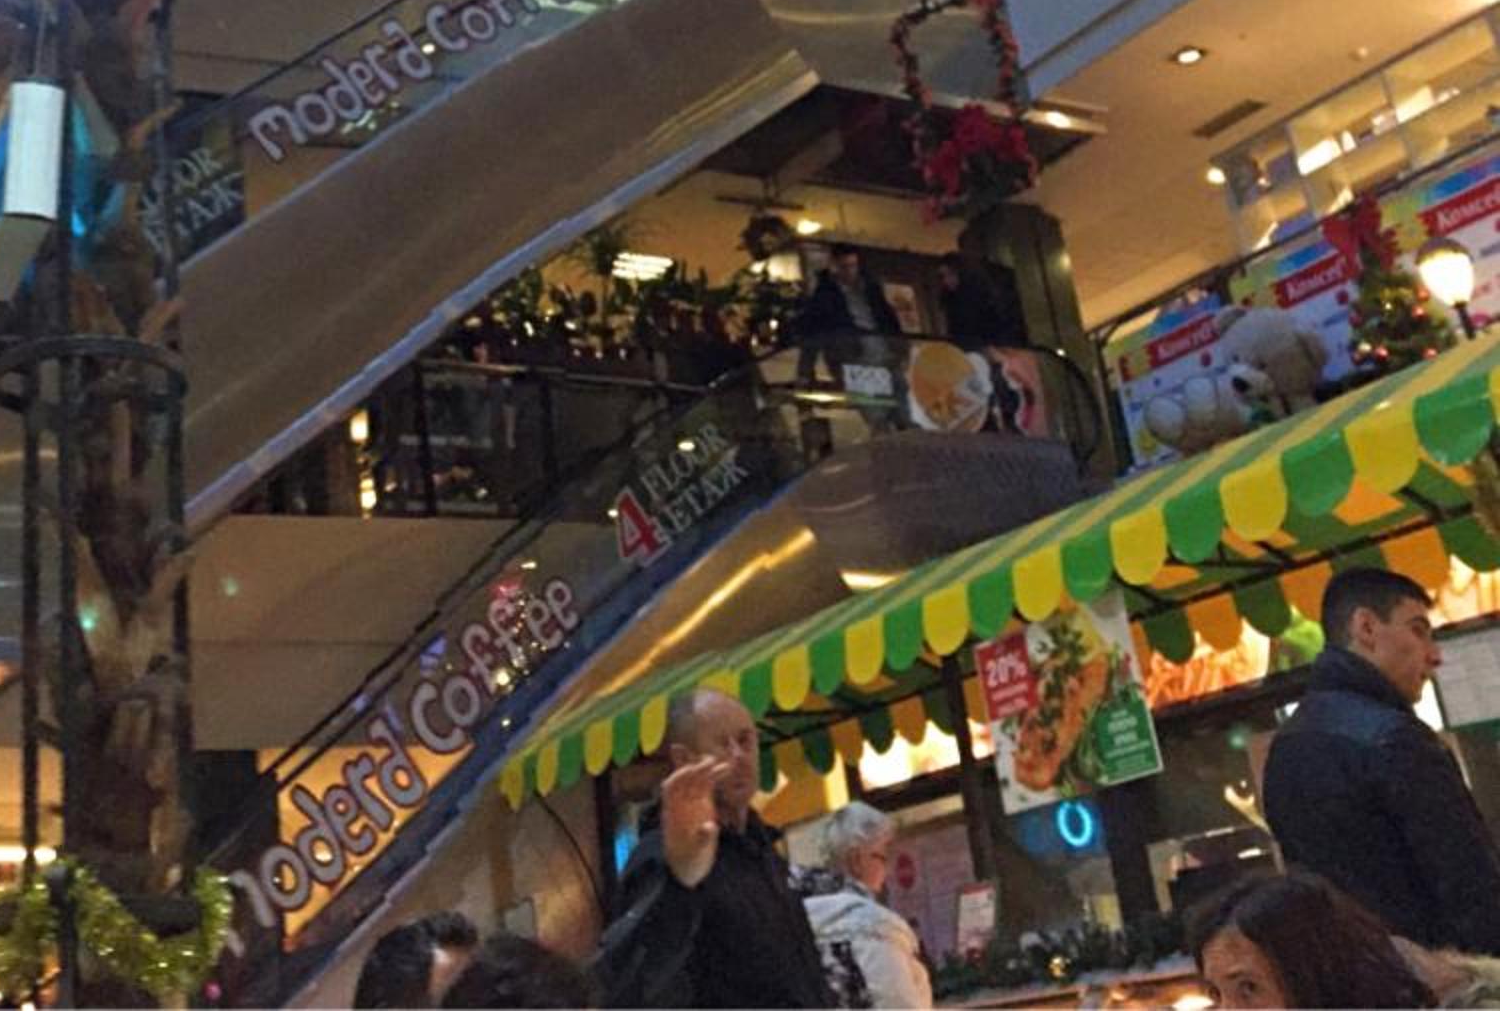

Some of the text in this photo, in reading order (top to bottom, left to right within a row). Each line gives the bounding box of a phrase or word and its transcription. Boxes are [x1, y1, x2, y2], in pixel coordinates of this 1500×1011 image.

[615, 421, 728, 567] 4 FLOOR
[411, 579, 579, 753] Coffee
